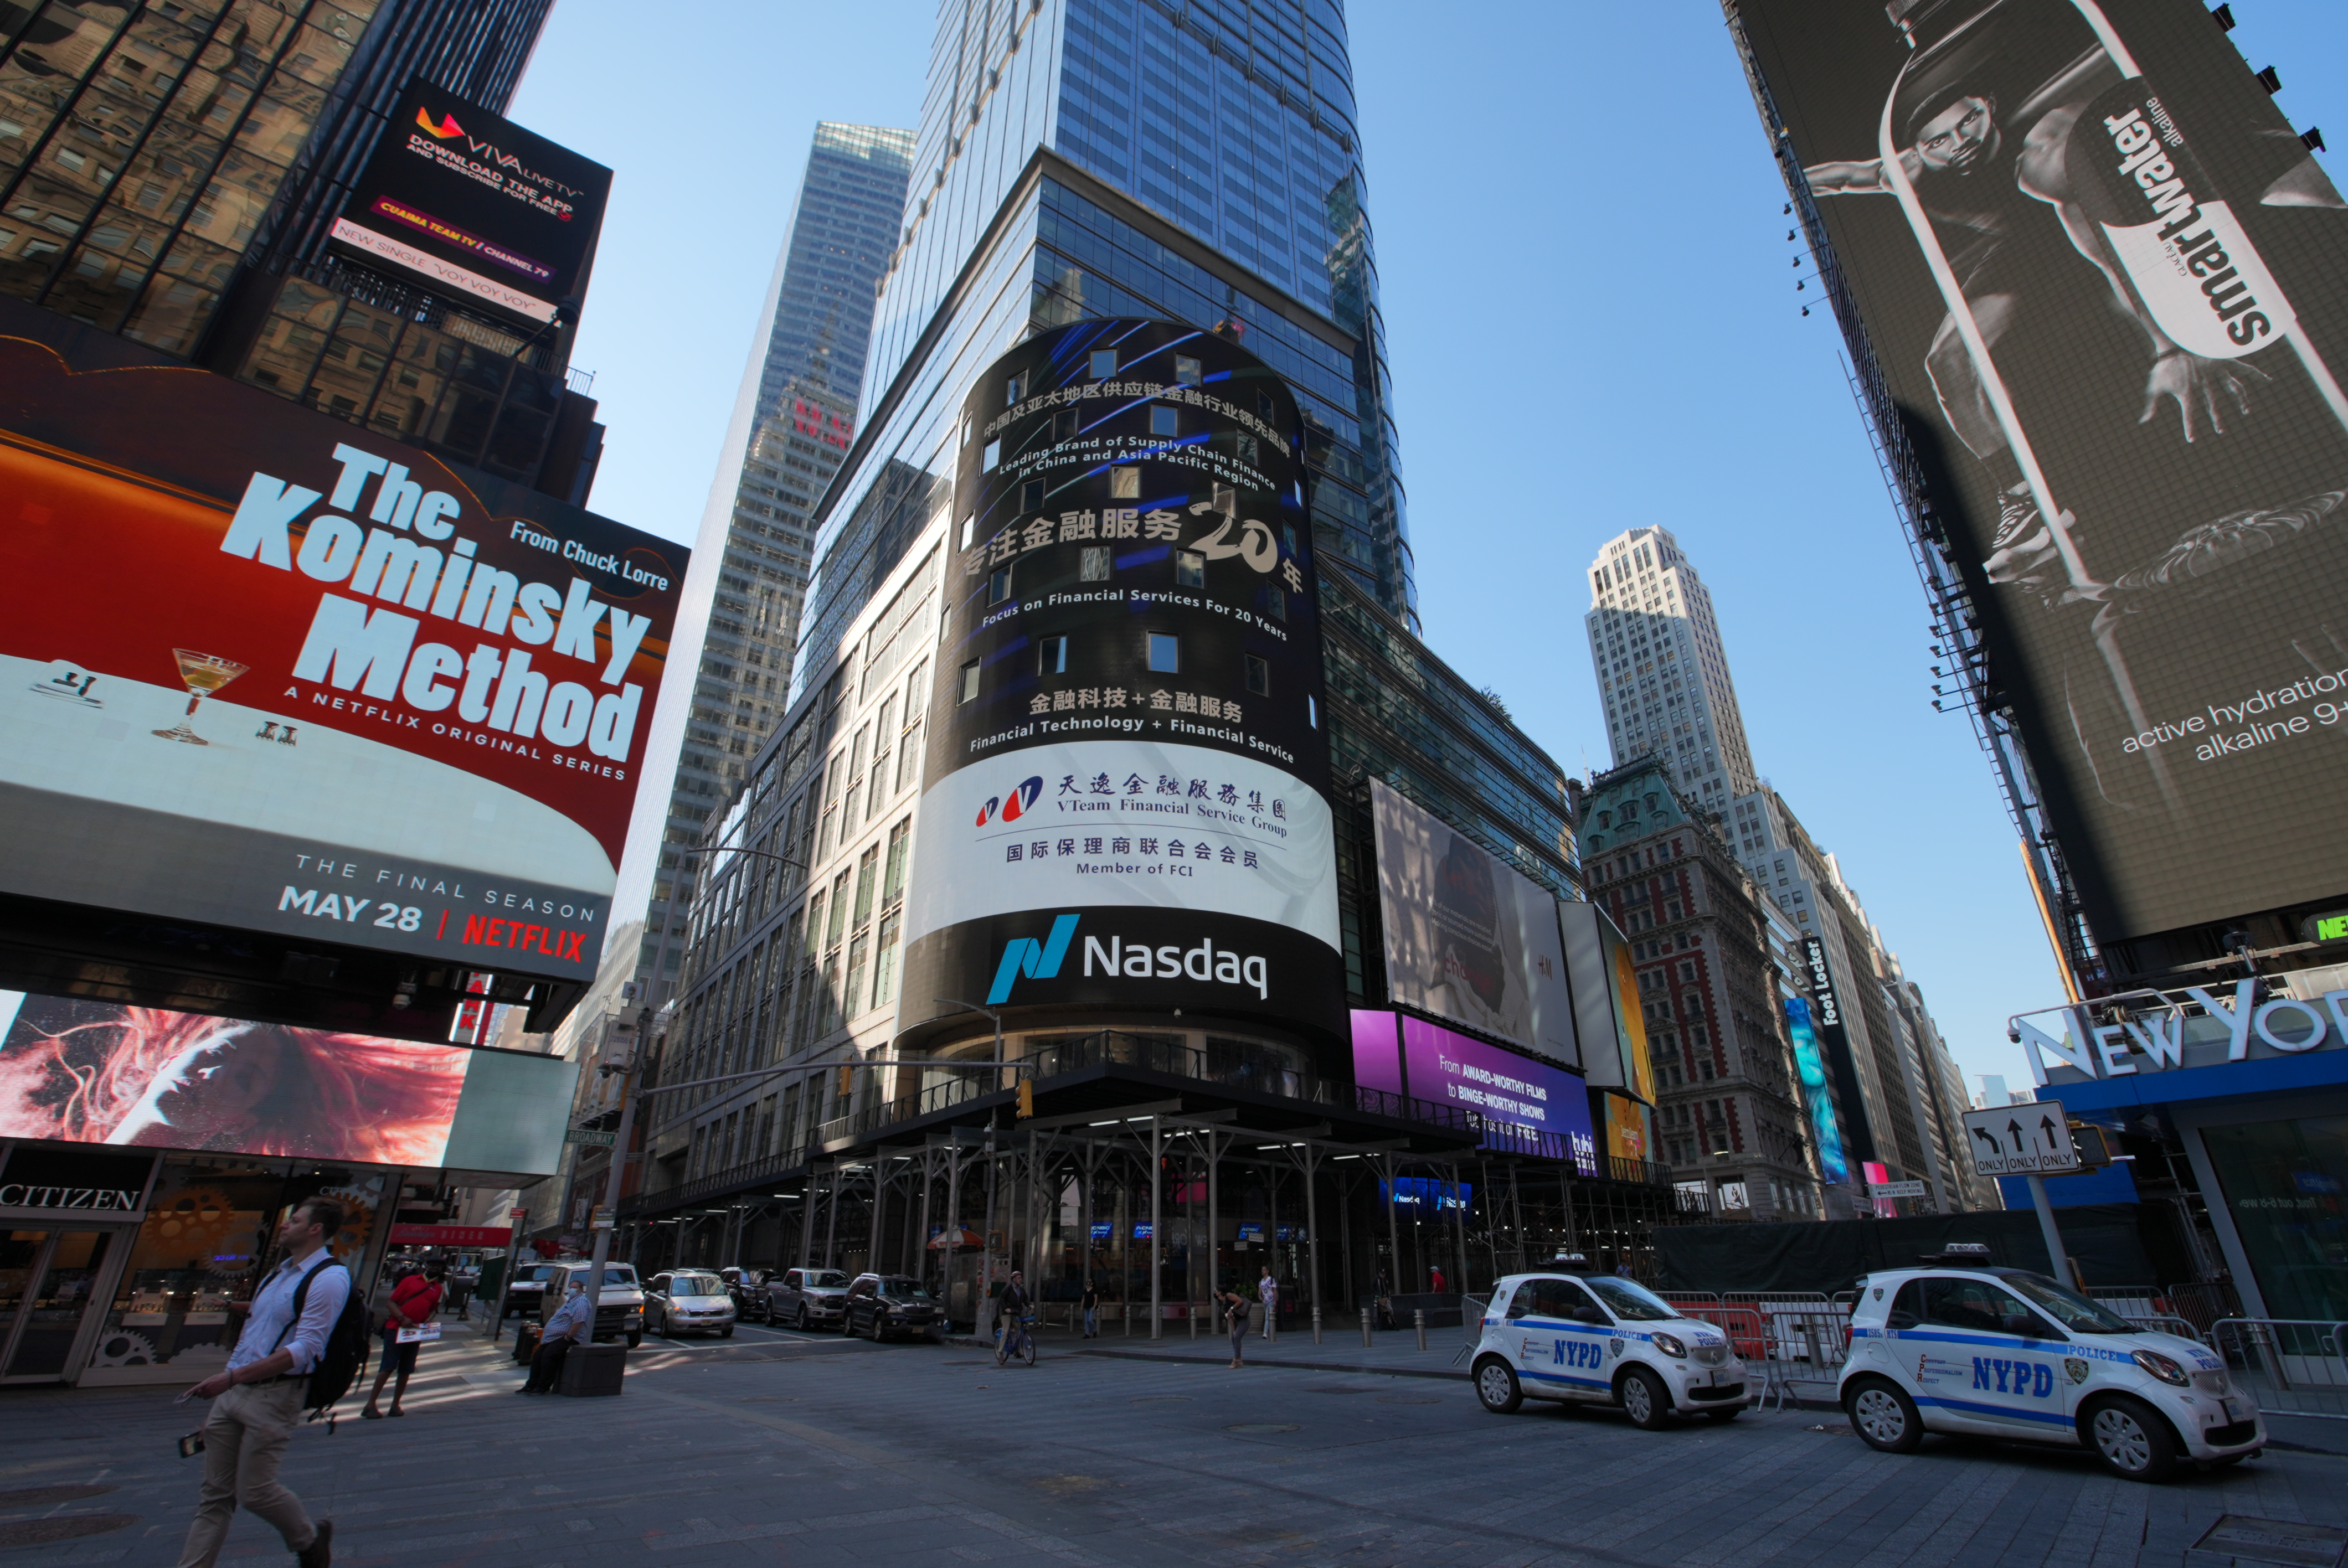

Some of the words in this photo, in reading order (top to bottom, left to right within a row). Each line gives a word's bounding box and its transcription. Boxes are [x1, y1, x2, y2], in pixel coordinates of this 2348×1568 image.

[2146, 96, 2184, 147] alkaline
[406, 143, 434, 159] AND
[434, 156, 501, 190] SUBSCRIBE
[503, 187, 527, 203] FOR
[529, 199, 557, 215] FREE
[409, 134, 503, 182] DOWNLOAD
[508, 178, 539, 199] THE
[542, 195, 573, 214] APP
[380, 202, 428, 227] CUAIMA
[429, 223, 460, 241] TEAM
[461, 234, 477, 246] TV
[483, 247, 533, 272] CHANNEL
[533, 267, 549, 277] 79
[2104, 107, 2271, 346] smartwater
[339, 226, 374, 245] NEW
[377, 242, 426, 267] SINGLE
[470, 279, 500, 297] VOY
[2162, 241, 2187, 276] GLACÉAU
[1000, 447, 1049, 474] Leading
[1055, 438, 1100, 453] Brand
[1106, 436, 1122, 446] of
[1128, 436, 1182, 453] Supply
[1187, 443, 1227, 463] Chain
[1233, 458, 1275, 491] Finance
[1019, 466, 1032, 478] in
[1036, 453, 1077, 471] China
[1083, 449, 1112, 461] and
[1117, 448, 1151, 461] Asia
[1158, 451, 1209, 471] Pacific
[1214, 465, 1259, 491] Region
[329, 442, 460, 540] The
[510, 520, 558, 554] From
[563, 540, 619, 575] Chuck
[622, 560, 668, 591] Lorre
[964, 508, 1182, 576] 专注金融服务
[1283, 557, 1303, 594] 年
[220, 471, 651, 685] Kominsky
[982, 605, 1019, 628] Focus
[1024, 599, 1043, 611] on
[1049, 589, 1124, 606] Financial
[1130, 589, 1199, 607] Services
[1206, 599, 1229, 615] For
[1234, 608, 1252, 622] 20
[1255, 616, 1287, 641] Years
[291, 592, 643, 763] Method
[284, 687, 297, 698] A
[312, 693, 421, 729] NETFLIX
[431, 723, 541, 759] ORIGINAL
[552, 754, 626, 781] SERIES
[970, 722, 1033, 752] Financial
[1040, 715, 1144, 733] Technology
[1171, 720, 1244, 745] Financial
[1249, 736, 1294, 764] Service
[2122, 716, 2206, 752] active
[2196, 716, 2310, 760] alkaline
[1057, 799, 1111, 812] VTeam
[1119, 800, 1189, 815] Financial
[1197, 805, 1245, 824] Service
[1252, 816, 1287, 838] Group
[1006, 837, 1258, 869] 国际保理商联合会会员
[1077, 863, 1140, 875] Member
[1147, 863, 1163, 875] of
[1170, 865, 1193, 877] FCI
[296, 854, 357, 878] THE
[376, 869, 465, 898] FINAL
[485, 890, 594, 921] SEASON
[278, 886, 370, 922] MAY
[374, 902, 423, 932] 28
[462, 914, 587, 962] NETFLIX
[2317, 915, 2348, 940] NE
[1084, 936, 1268, 1000] Nasdaq
[459, 973, 483, 1029] ARK
[1818, 993, 1839, 1026] Foot
[2015, 1008, 2185, 1087] NEW
[1440, 1054, 1460, 1075] From
[1463, 1064, 1525, 1095] AWARD-WORTHY
[1526, 1083, 1547, 1101] FILMS
[1448, 1082, 1456, 1097] to
[1458, 1085, 1517, 1114] BINGE-WORTHY
[1520, 1102, 1545, 1121] SHOWS
[1465, 1111, 1480, 1128] Tub
[568, 1131, 614, 1145] BROADWAY
[1571, 1131, 1594, 1158] tubi
[1979, 1159, 2005, 1172] ONLY
[2009, 1156, 2037, 1169] ONLY
[2043, 1154, 2071, 1167] ONLY
[0, 1184, 140, 1211] CITIZEN
[1446, 1197, 1466, 1211] Nasaq
[1554, 1339, 1602, 1370] NYPD
[1613, 1329, 1641, 1340] POLICE
[2068, 1345, 2116, 1361] POLICE
[1972, 1356, 2053, 1398] NYPD
